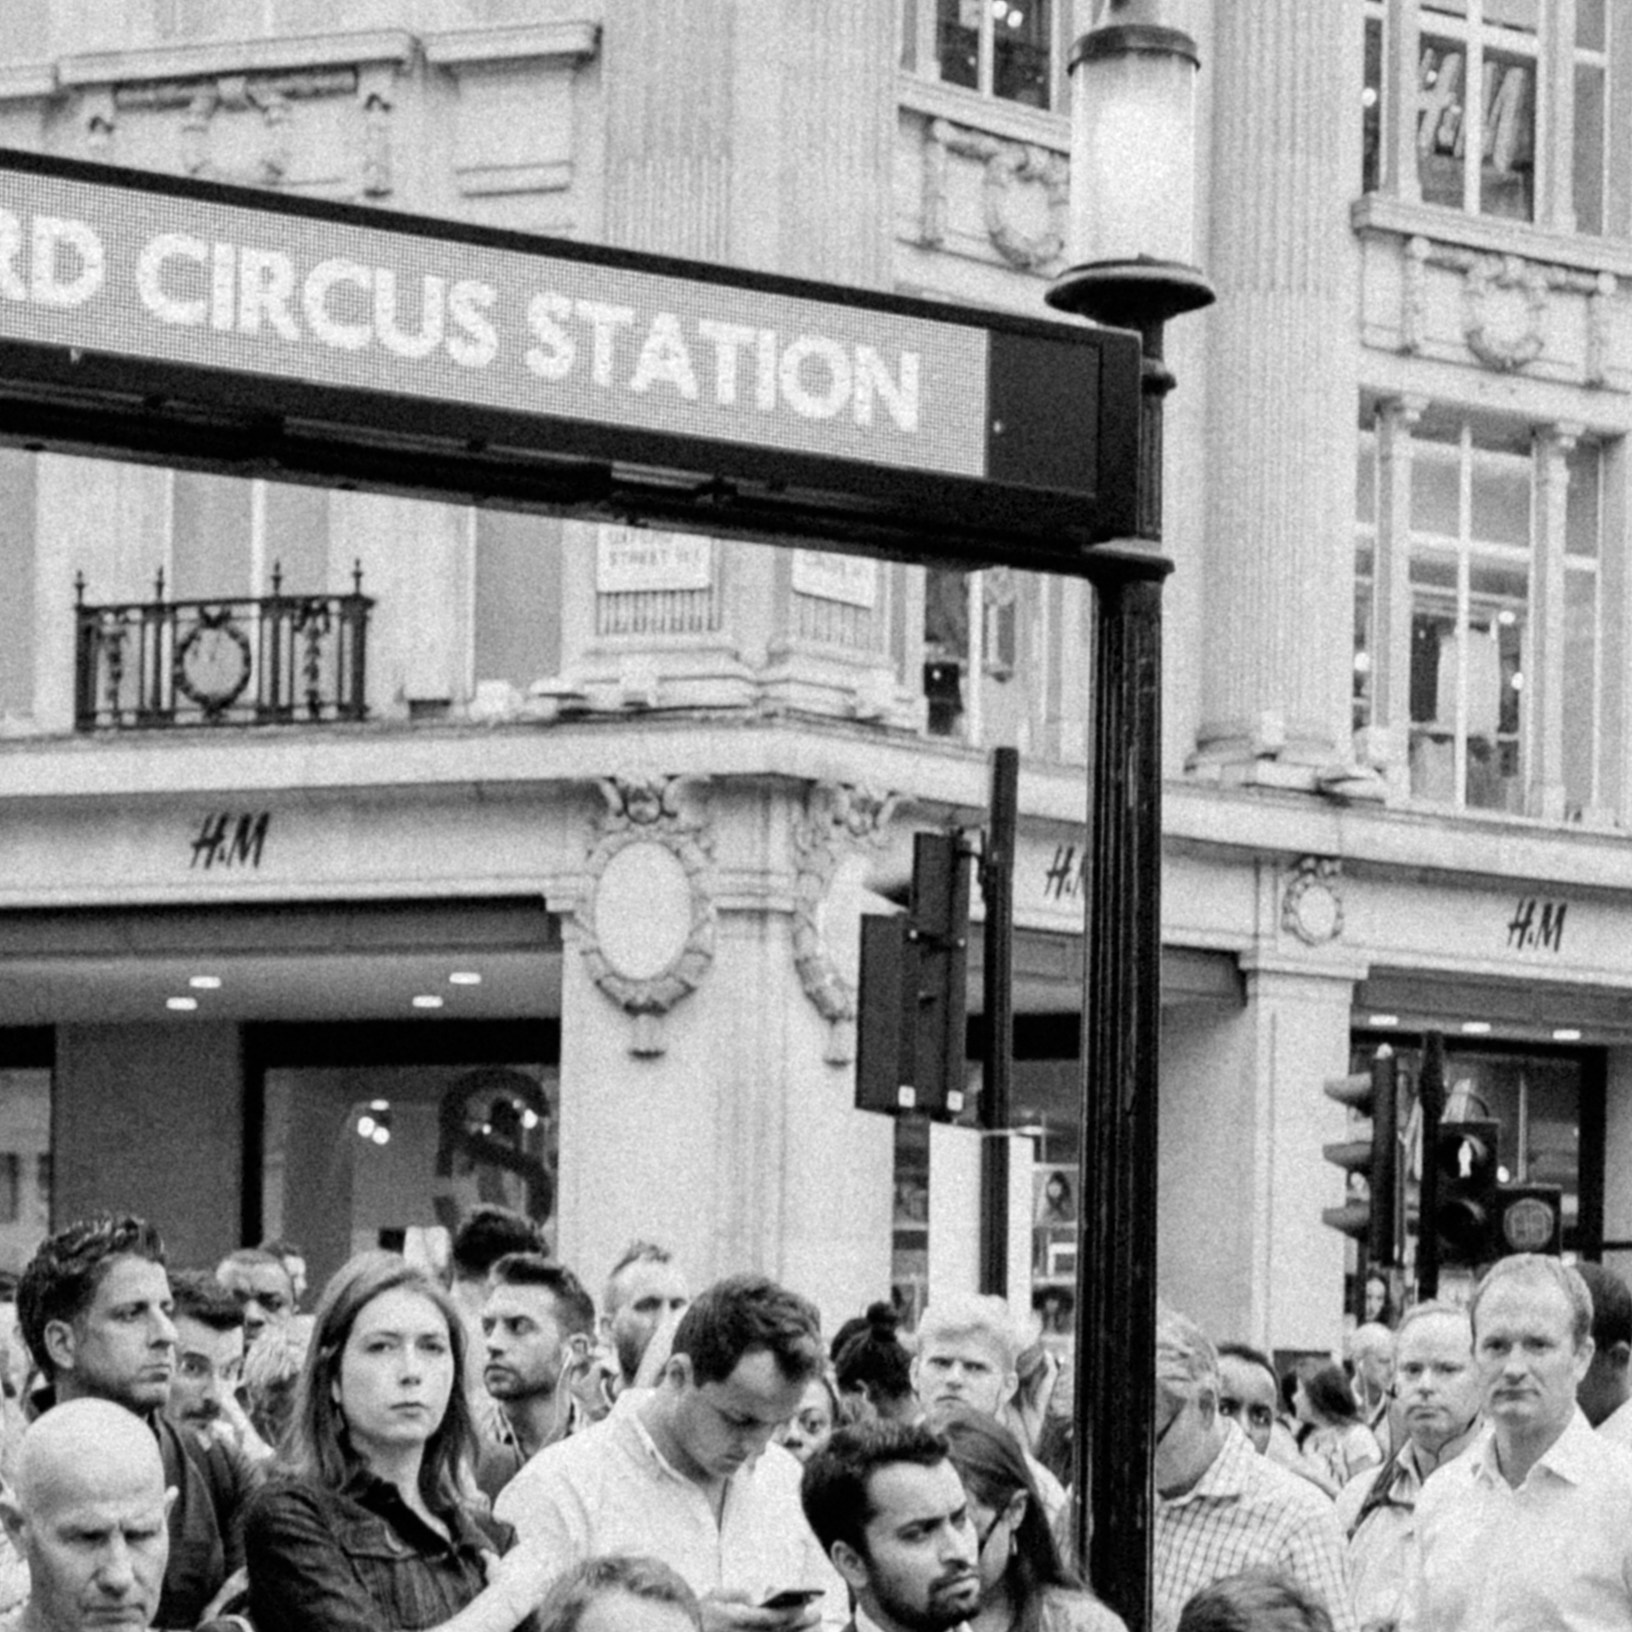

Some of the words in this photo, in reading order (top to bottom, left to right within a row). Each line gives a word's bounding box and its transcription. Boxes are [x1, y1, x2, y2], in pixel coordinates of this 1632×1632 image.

[136, 233, 499, 368] CIRCUS
[524, 291, 920, 433] STATION
[190, 811, 270, 870] H&M
[1507, 898, 1567, 952] H&M
